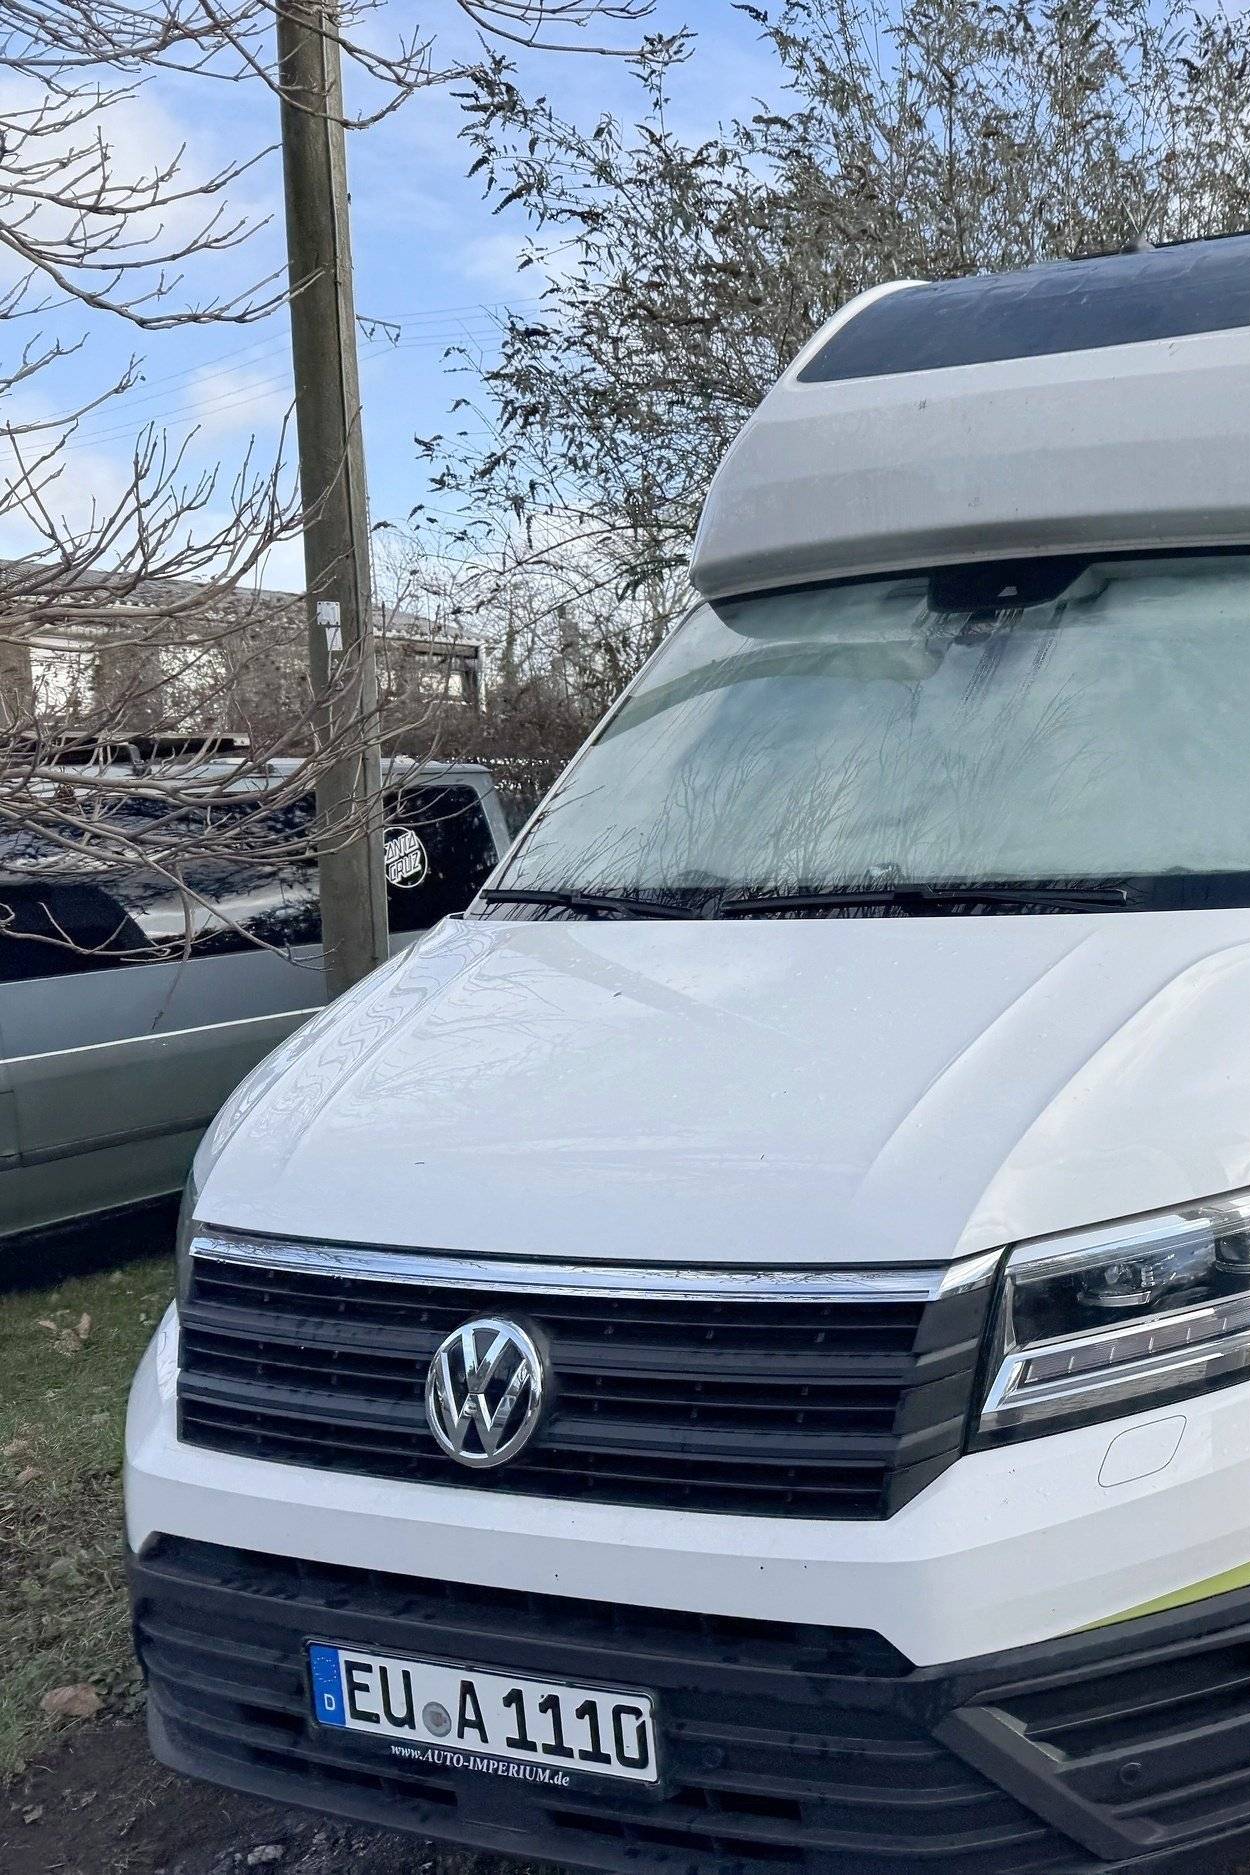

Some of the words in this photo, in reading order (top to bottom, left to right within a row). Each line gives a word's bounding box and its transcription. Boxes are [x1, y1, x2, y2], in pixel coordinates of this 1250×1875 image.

[384, 831, 420, 864] ANTA
[388, 850, 422, 883] CRUZ
[324, 1693, 336, 1711] D
[344, 1659, 416, 1730] EU
[457, 1679, 489, 1744] A
[502, 1688, 650, 1769] 1110
[390, 1745, 570, 1787] www.AUTO-IMPERIUM.de
